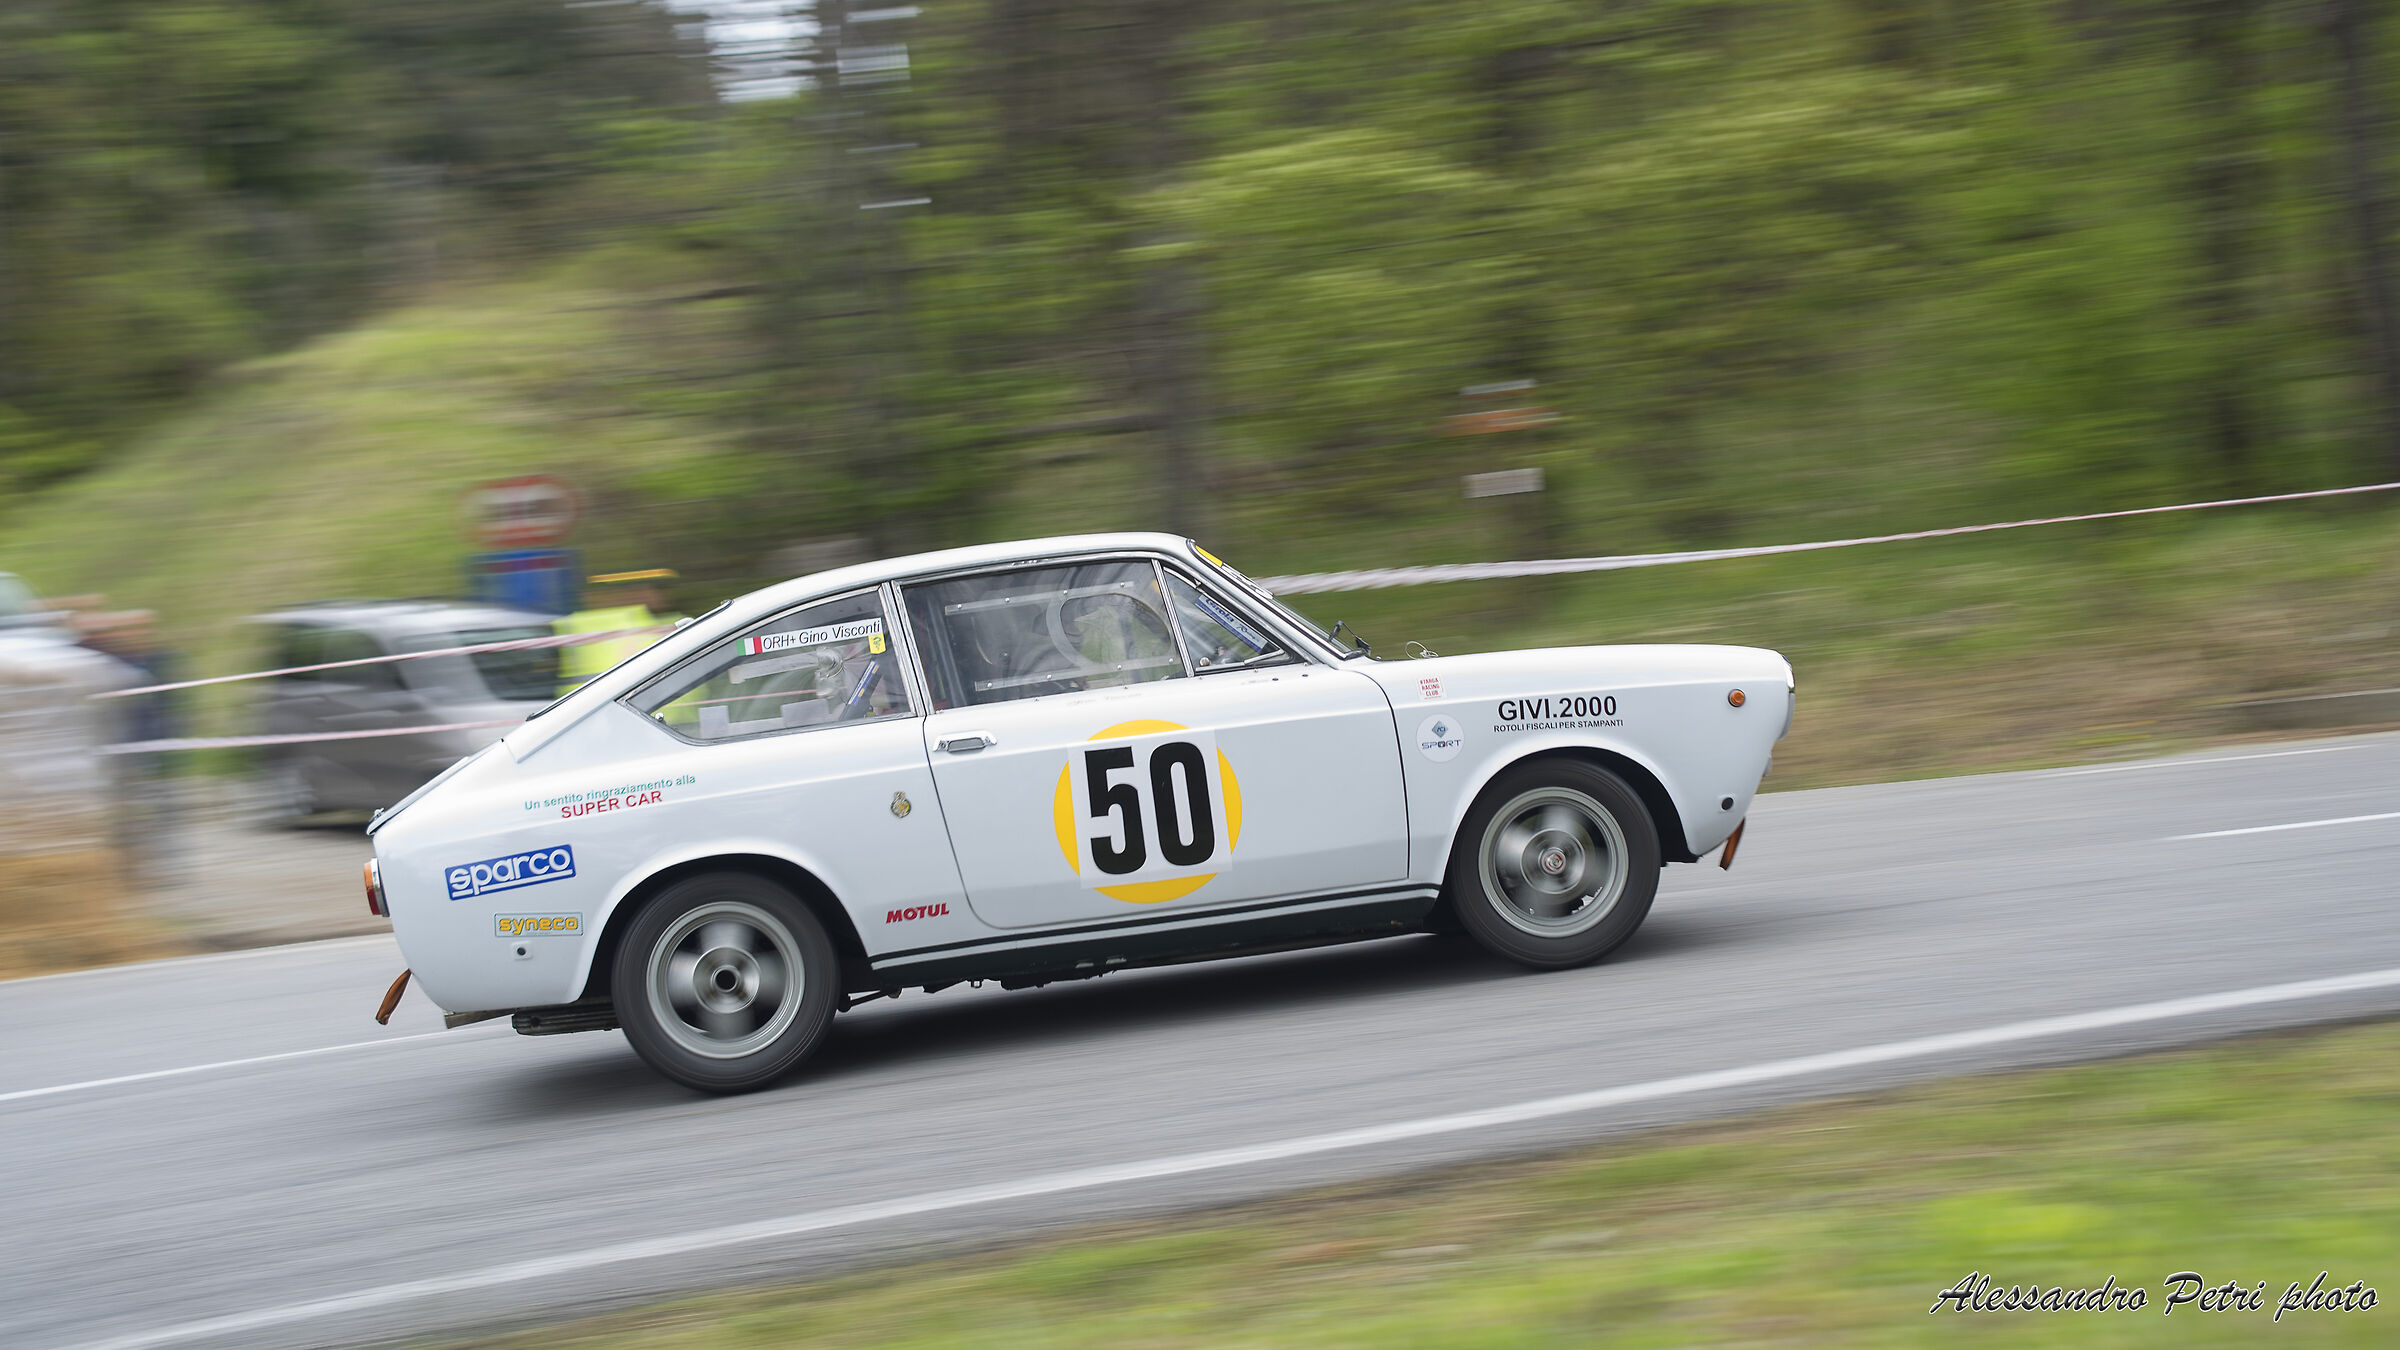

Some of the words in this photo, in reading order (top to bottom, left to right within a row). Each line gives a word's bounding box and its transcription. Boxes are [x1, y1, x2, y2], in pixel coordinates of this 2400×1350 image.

[799, 630, 828, 644] Gino
[832, 620, 881, 639] Visconti
[1498, 695, 1617, 721] GIVI.2000
[1493, 724, 1525, 733] ROTOLI
[1526, 722, 1558, 731] FISCALI
[1559, 721, 1576, 729] PER
[1577, 719, 1623, 728] STAMPANTI
[1421, 739, 1461, 750] SPORT
[524, 800, 541, 811] Un
[543, 793, 583, 808] sentito
[586, 779, 673, 801] ringraziamento
[675, 774, 696, 786] alla
[561, 798, 620, 819] SUPER
[625, 790, 663, 808] CAR
[1084, 742, 1216, 876] 50
[449, 848, 571, 896] sparco
[886, 903, 950, 924] MOTUL
[499, 917, 579, 936] syneco
